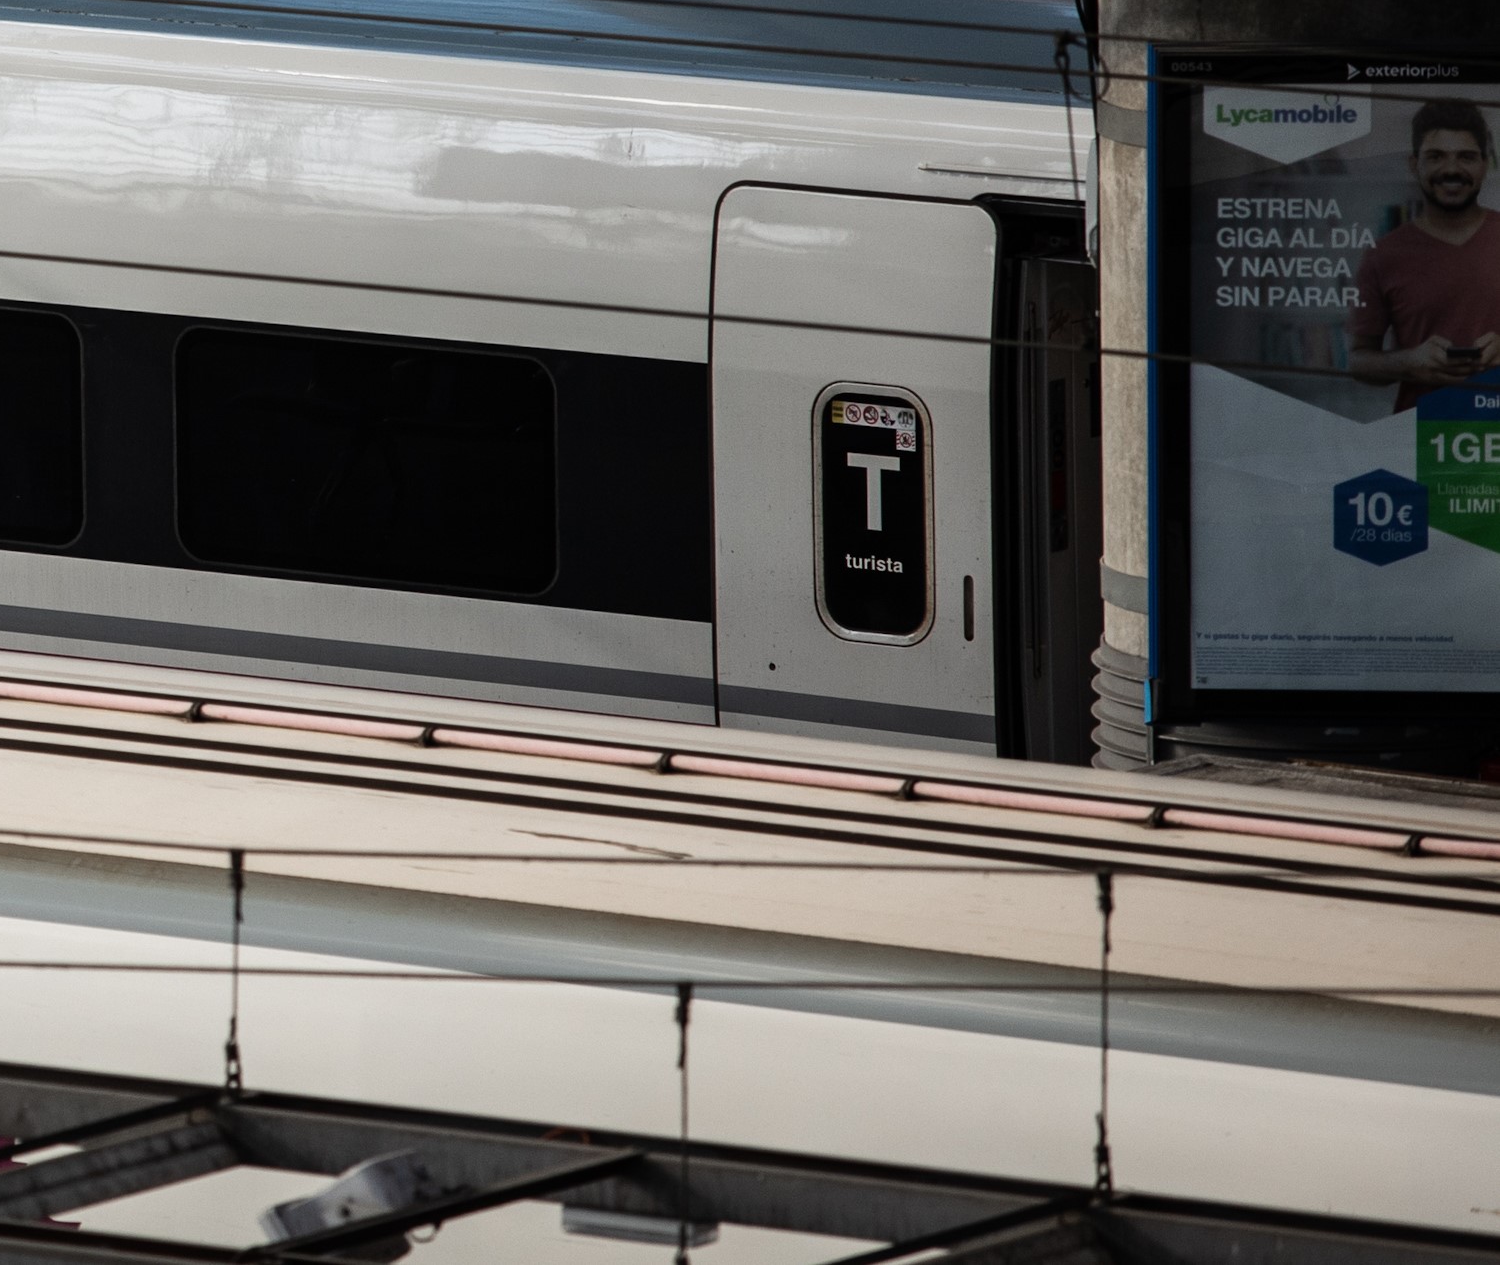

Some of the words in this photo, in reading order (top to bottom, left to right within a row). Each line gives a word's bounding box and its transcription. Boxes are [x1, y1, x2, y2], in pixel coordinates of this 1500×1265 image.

[1171, 61, 1213, 74] 00543
[1365, 63, 1459, 79] exteriorplus
[1216, 104, 1357, 126] Lycamobile
[1216, 197, 1342, 219] ESTRENA
[1216, 227, 1284, 249] GIGA
[1289, 228, 1324, 249] AL
[1331, 223, 1377, 249] DÍA
[1216, 256, 1234, 277] Y
[1241, 257, 1352, 278] NAVEGA
[1216, 286, 1260, 308] SIN
[1268, 287, 1367, 308] PARAR.
[847, 452, 900, 531] T
[1351, 528, 1376, 542] /28
[1381, 528, 1412, 542] días
[845, 553, 903, 573] turista
